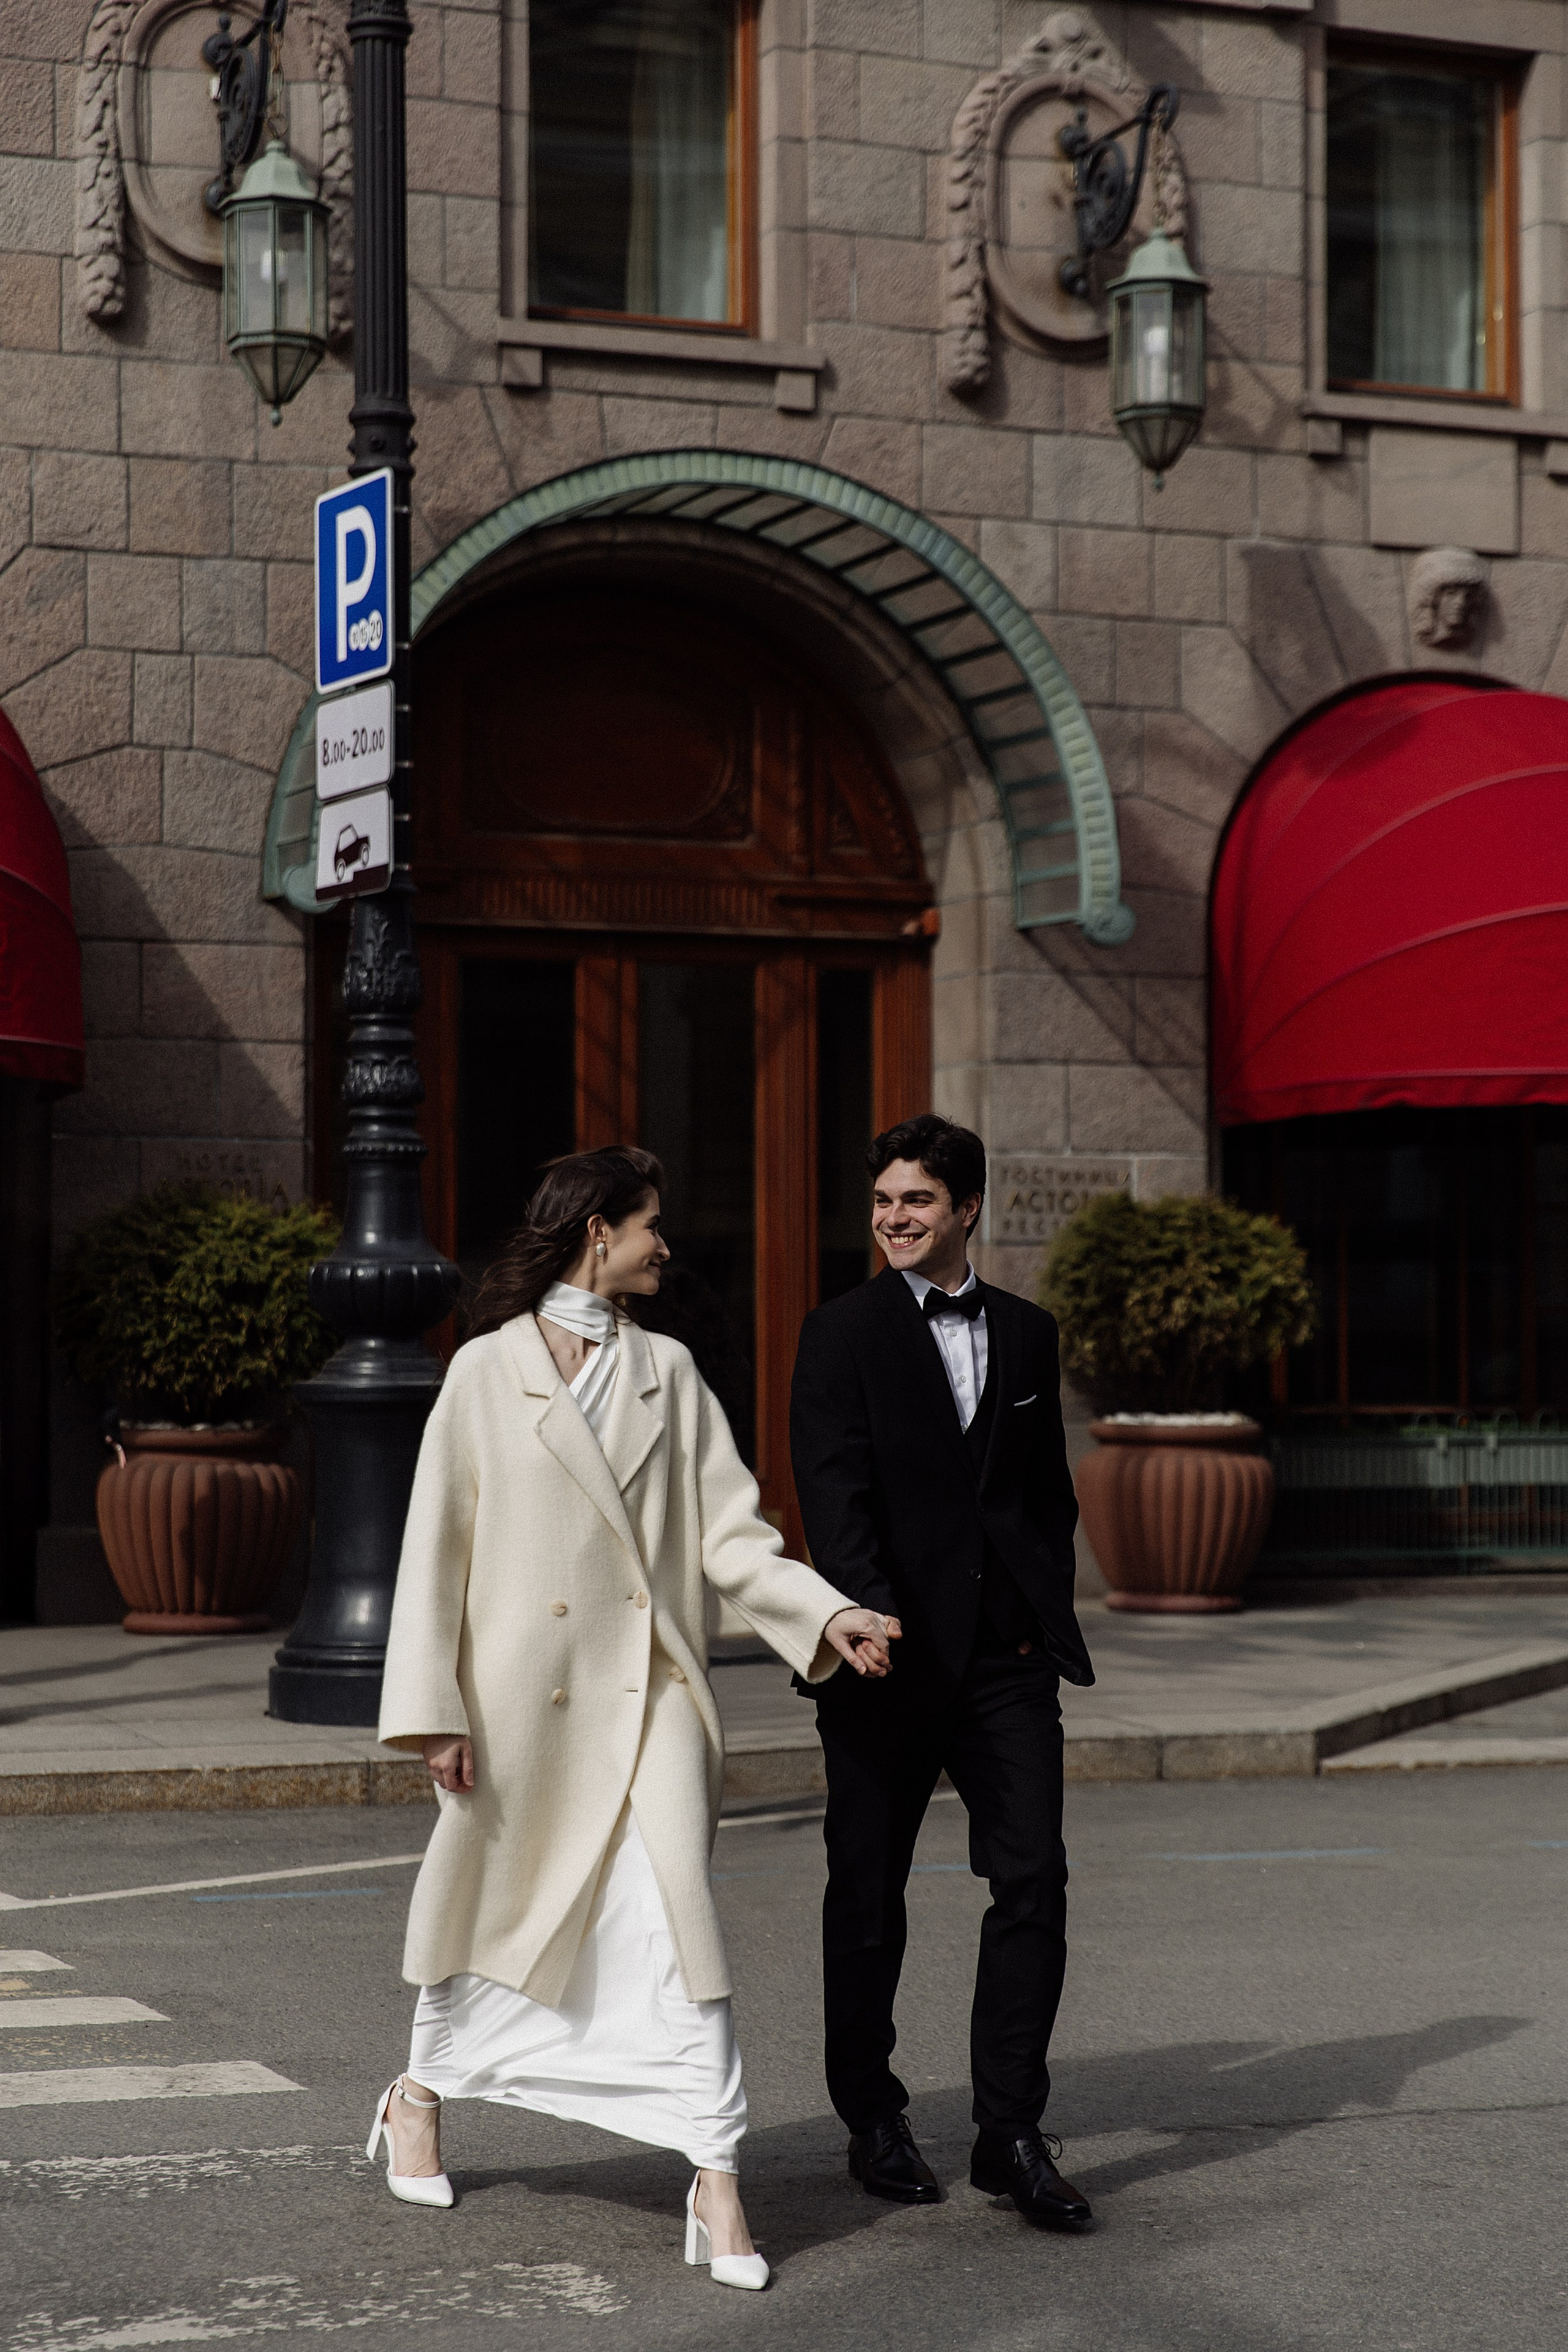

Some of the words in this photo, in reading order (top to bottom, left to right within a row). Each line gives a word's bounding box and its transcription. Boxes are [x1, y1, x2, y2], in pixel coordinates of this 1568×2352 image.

[336, 504, 377, 663] P
[370, 619, 382, 642] 20
[322, 727, 385, 767] 8.00-20.00
